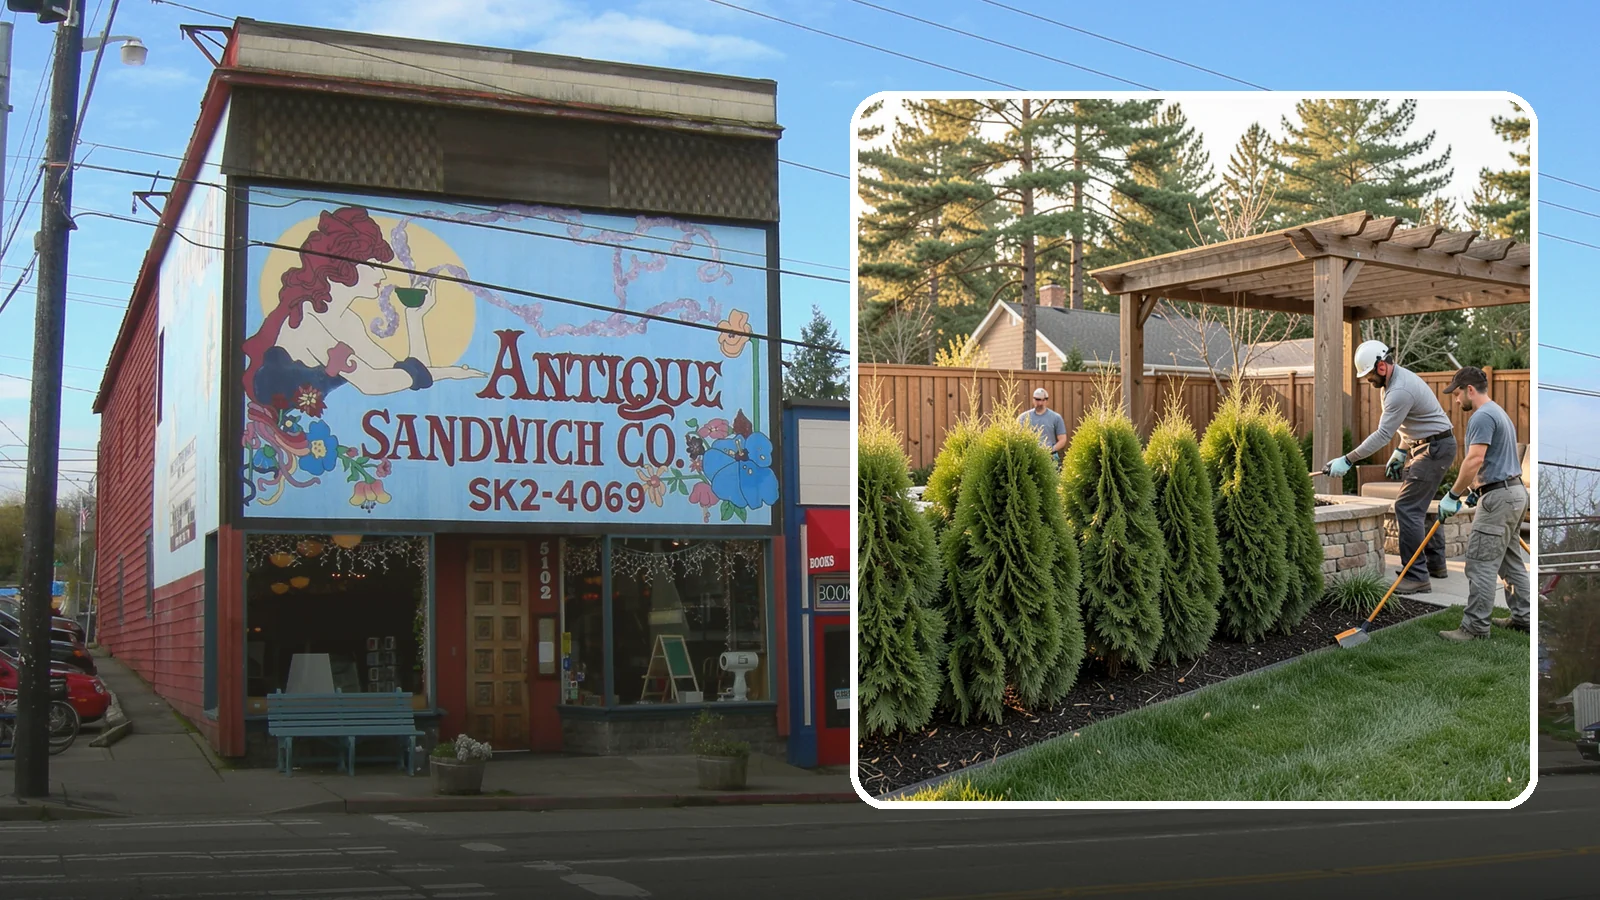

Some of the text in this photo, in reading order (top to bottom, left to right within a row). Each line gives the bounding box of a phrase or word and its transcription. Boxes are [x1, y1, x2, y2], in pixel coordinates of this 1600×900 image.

[476, 329, 723, 421] ANTIQUE
[362, 409, 685, 469] SANDWICH CO.
[468, 477, 646, 513] SK2-4069
[540, 542, 551, 600] 5102
[809, 555, 835, 569] BOOKS
